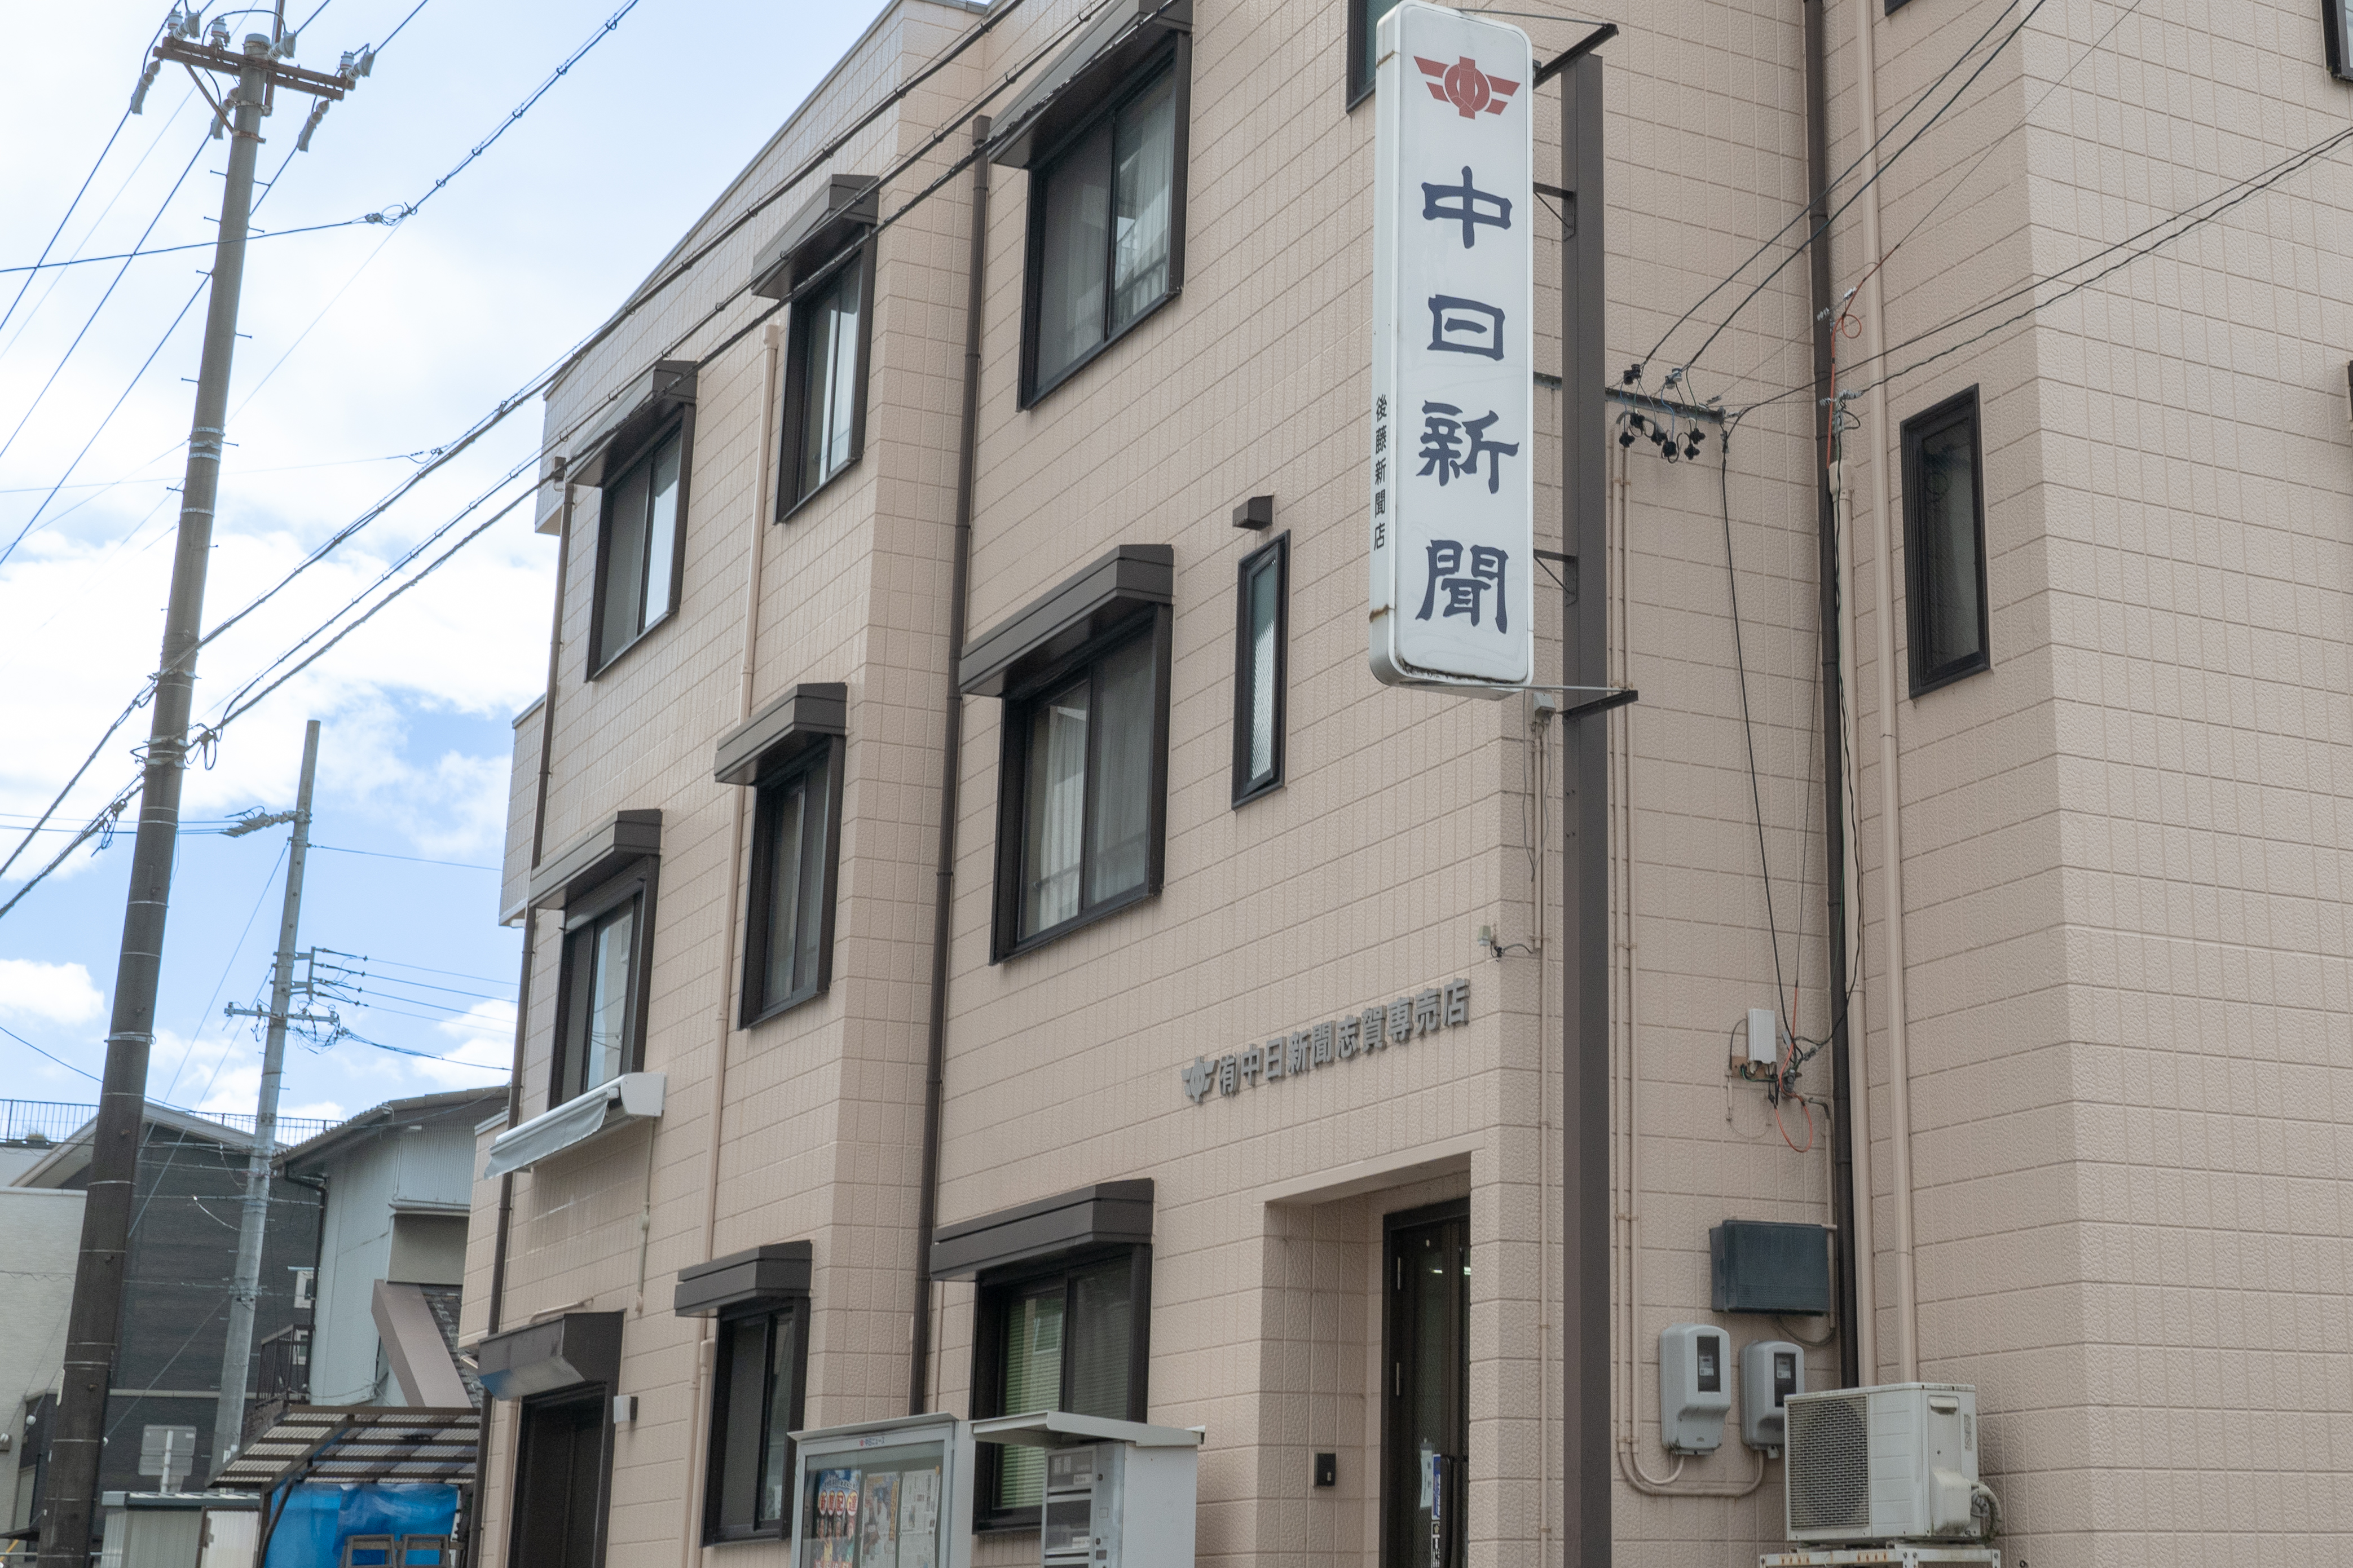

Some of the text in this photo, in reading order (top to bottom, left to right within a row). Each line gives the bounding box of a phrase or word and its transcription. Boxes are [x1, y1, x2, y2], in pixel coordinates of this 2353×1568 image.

[1374, 394, 1387, 551] 後藤新聞店
[1415, 166, 1519, 634] 中日新聞
